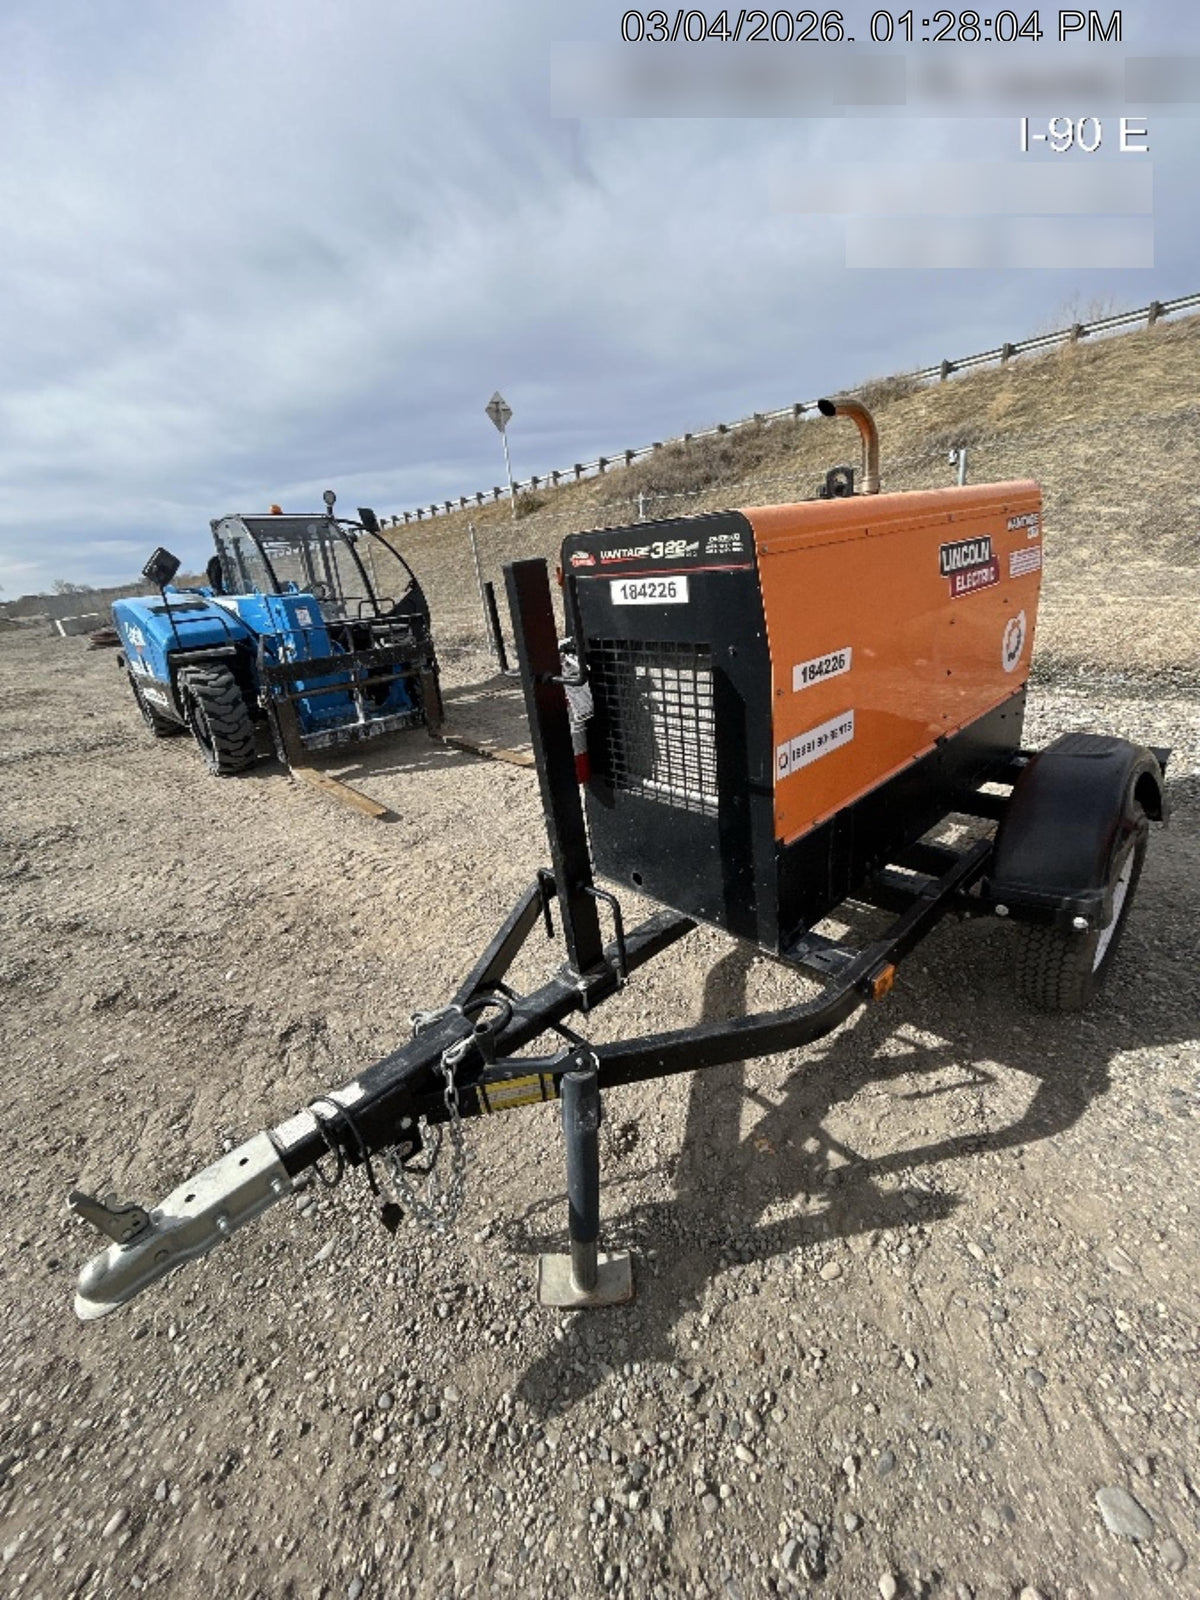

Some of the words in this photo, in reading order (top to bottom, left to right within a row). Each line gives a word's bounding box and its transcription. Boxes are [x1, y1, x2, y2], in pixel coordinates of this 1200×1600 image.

[650, 540, 688, 559] 322
[942, 541, 990, 572] LINCOLN
[620, 581, 677, 600] 184226
[955, 566, 996, 592] ELECTRIC
[801, 653, 846, 683] 184226
